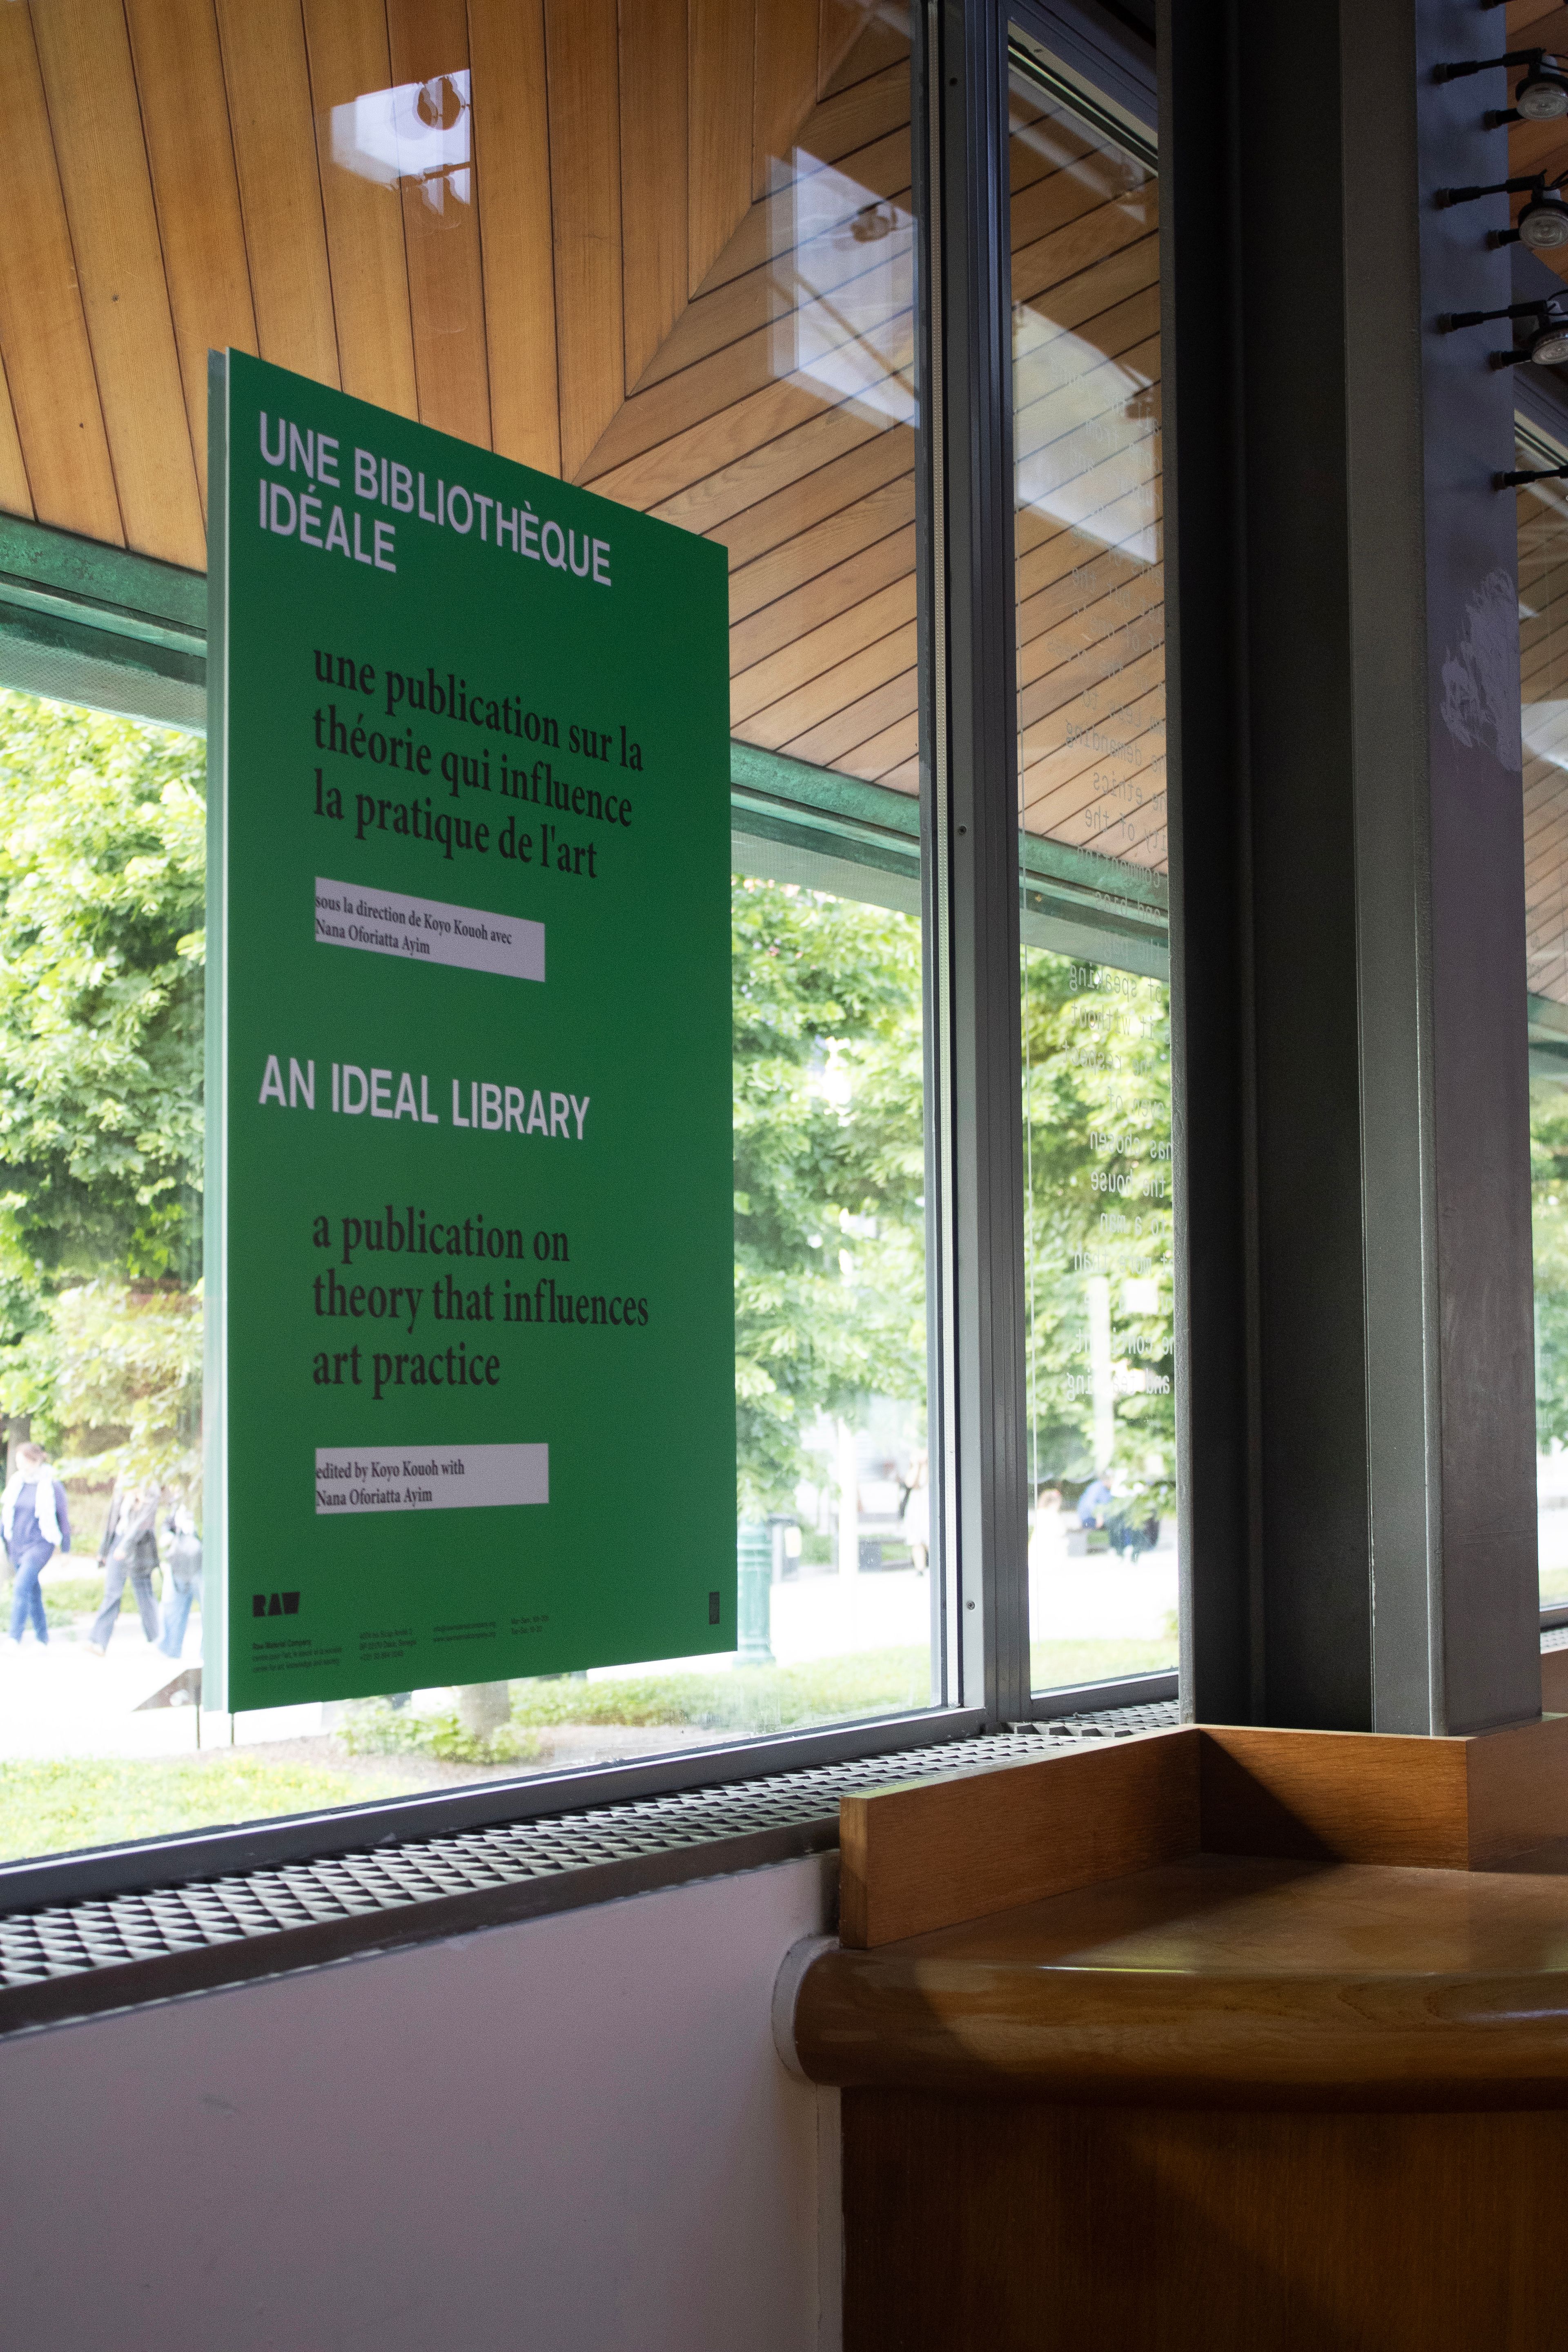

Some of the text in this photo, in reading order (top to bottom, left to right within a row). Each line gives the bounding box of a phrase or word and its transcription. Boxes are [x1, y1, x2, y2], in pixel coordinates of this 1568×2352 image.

[259, 410, 612, 587] UNE BIBLIOTHÈQUE
[259, 479, 396, 573] IDÉALE
[314, 649, 643, 771] une publication sur la
[314, 704, 632, 827] théorie qui influence
[314, 768, 597, 879] la pratique de l'art
[315, 893, 512, 945] sous la direction de Koyo Kouoh avec
[315, 920, 431, 957] Nana Oforiatta Ayim
[258, 1054, 590, 1140] AN IDEAL LIBRARY
[312, 1205, 570, 1265] a publication on
[313, 1269, 648, 1334] theory that influences
[313, 1343, 500, 1400] art practice
[316, 1459, 464, 1481] edited by Koyo Kouoh with
[316, 1486, 432, 1507] Nana Oforiatta Ayim
[253, 1591, 301, 1617] RAW
